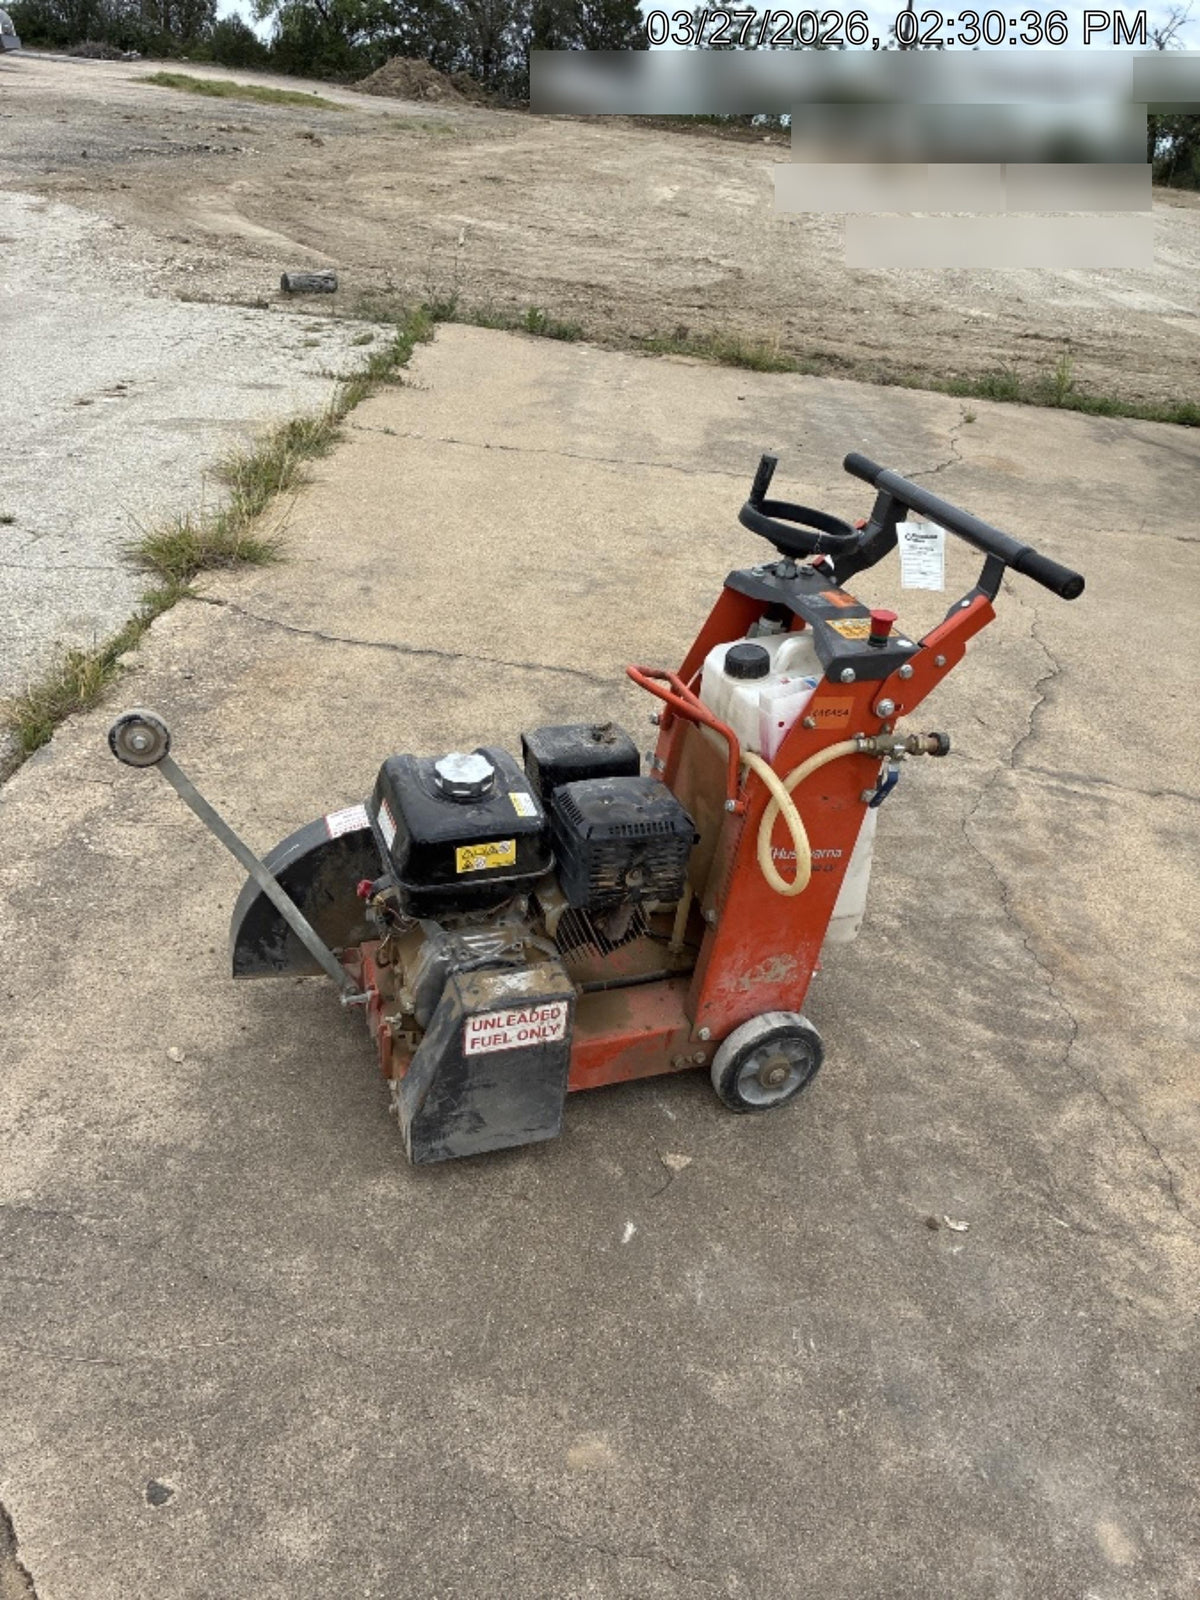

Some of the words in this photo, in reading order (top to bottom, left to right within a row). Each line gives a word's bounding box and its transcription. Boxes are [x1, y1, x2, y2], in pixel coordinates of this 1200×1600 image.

[471, 1007, 561, 1032] UNLEADED
[470, 1032, 511, 1050] FUEL
[516, 1023, 561, 1041] ONLY
